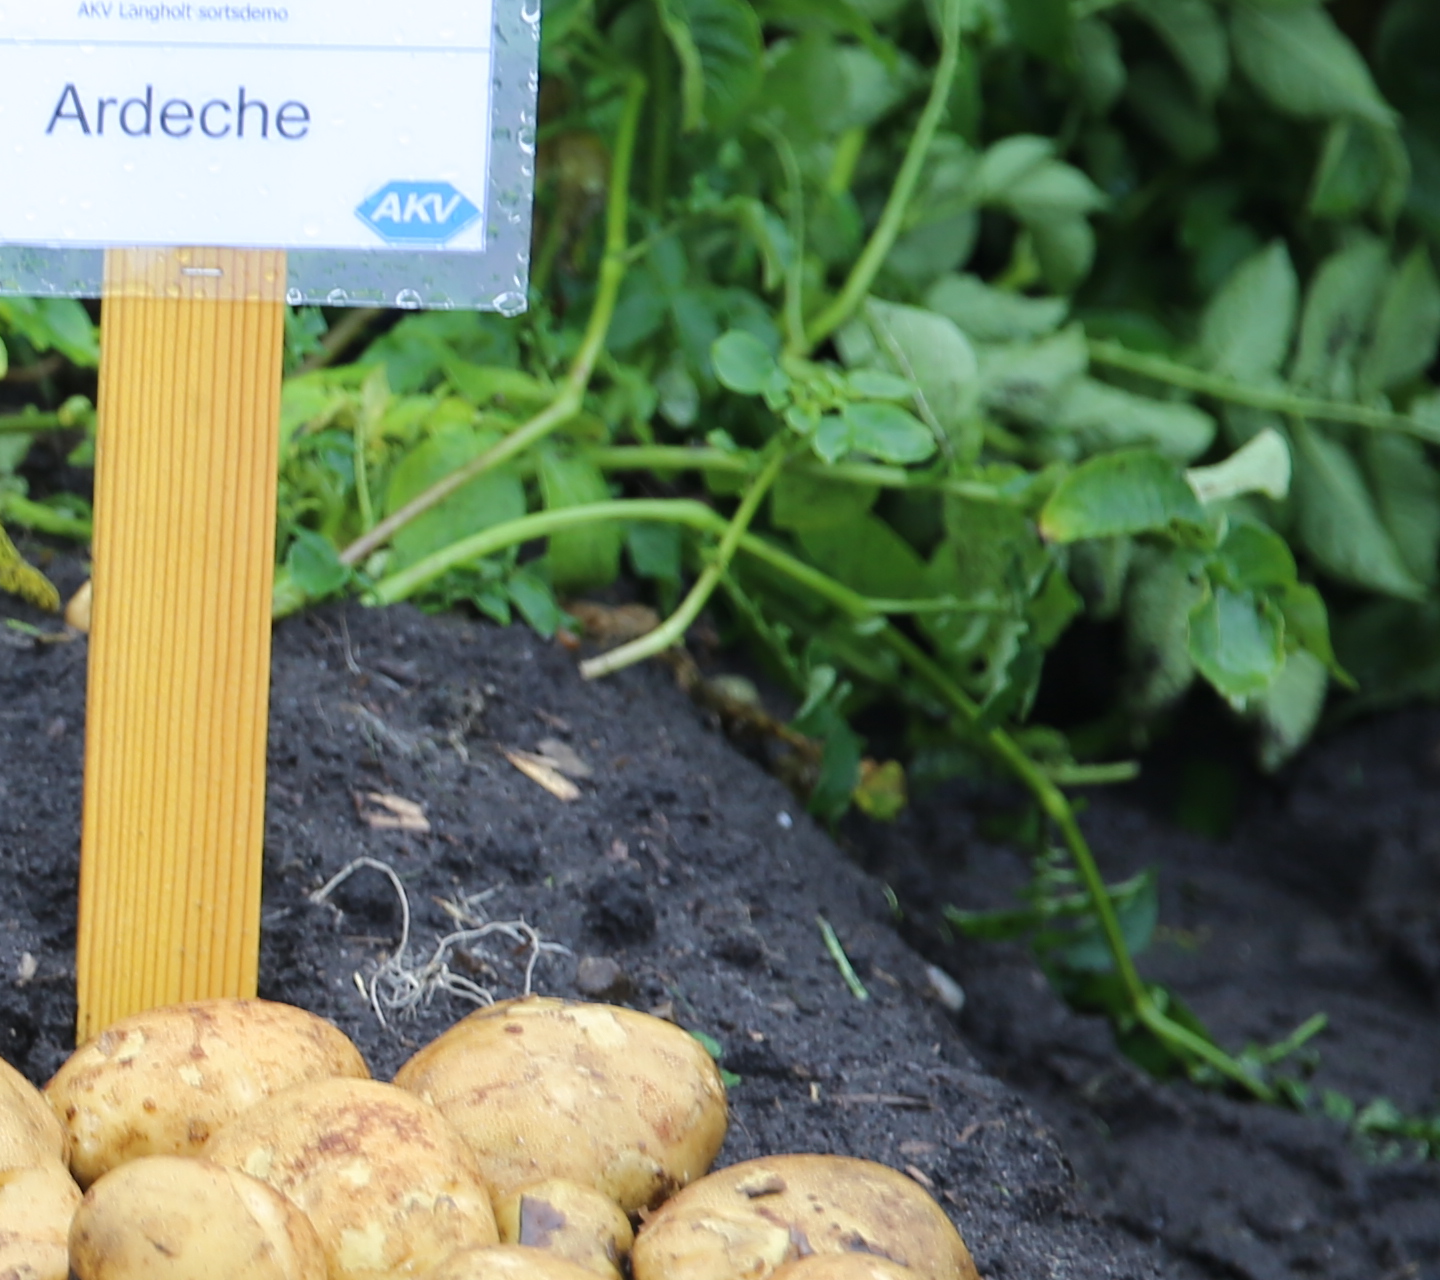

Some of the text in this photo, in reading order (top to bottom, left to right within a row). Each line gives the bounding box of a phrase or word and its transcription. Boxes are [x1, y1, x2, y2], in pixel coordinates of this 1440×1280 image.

[78, 0, 289, 25] AKV Langholt sortsdemo
[45, 84, 311, 140] Ardeche
[369, 191, 462, 224] AKV
